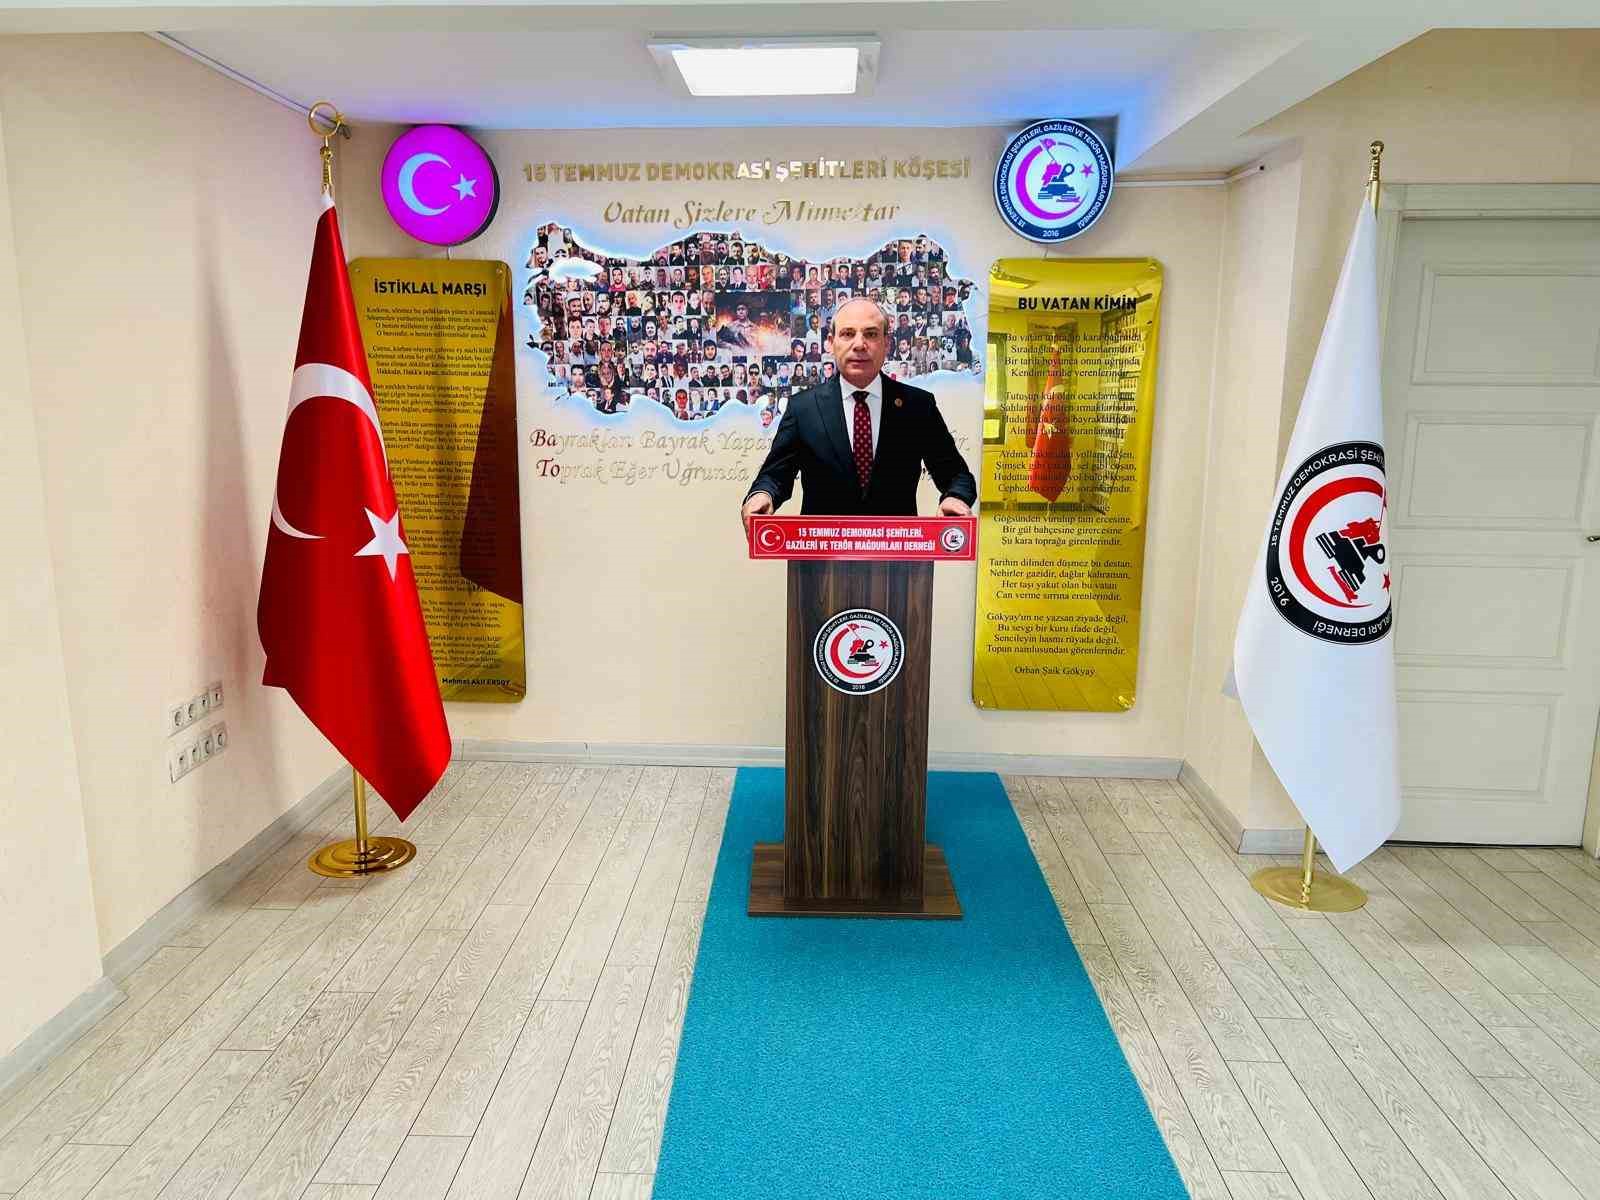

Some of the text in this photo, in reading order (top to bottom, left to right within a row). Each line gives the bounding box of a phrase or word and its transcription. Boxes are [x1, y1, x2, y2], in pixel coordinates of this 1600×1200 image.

[523, 161, 546, 182] 15
[551, 162, 641, 183] TEMMUZ
[646, 158, 770, 182] DEMOKRASİ
[775, 157, 886, 183] ŞEHİTLERİ
[1042, 230, 1060, 238] 2016
[374, 278, 487, 298] İSTİKLAL MARŞI
[1018, 294, 1137, 310] BU VATAN KİMİN
[641, 430, 714, 456] Bayrak
[718, 430, 773, 457] Yapa
[1294, 448, 1358, 487] DEMOKRASİ
[1273, 487, 1296, 532] TEMMUZ
[798, 527, 807, 537] 15
[808, 527, 840, 537] TEMMUZ
[1003, 526, 1015, 534] Bir
[785, 538, 818, 551] GAZİLERİ
[819, 540, 829, 551] VE
[830, 538, 853, 551] TERÖR
[1015, 537, 1033, 545] kara
[1035, 537, 1066, 547] toprağa
[990, 569, 1024, 578] Nehirler
[1058, 570, 1084, 580] dağlar
[1002, 580, 1017, 588] Her
[1036, 580, 1060, 591] yakut
[1061, 581, 1080, 589] olan
[1094, 582, 1118, 590] vatan
[1270, 576, 1290, 606] 2016
[996, 590, 1013, 599] Can
[1015, 592, 1041, 600] verme
[1046, 615, 1074, 624] yazsan
[998, 623, 1010, 631] Bu
[1012, 624, 1033, 634] sevgi
[1049, 624, 1068, 632] kuru
[1312, 620, 1366, 637] DERNEĞİ
[1066, 635, 1094, 646] rüyada
[987, 644, 1012, 655] Topun
[1015, 665, 1040, 674] Orhan
[1063, 666, 1095, 677] Gökyay
